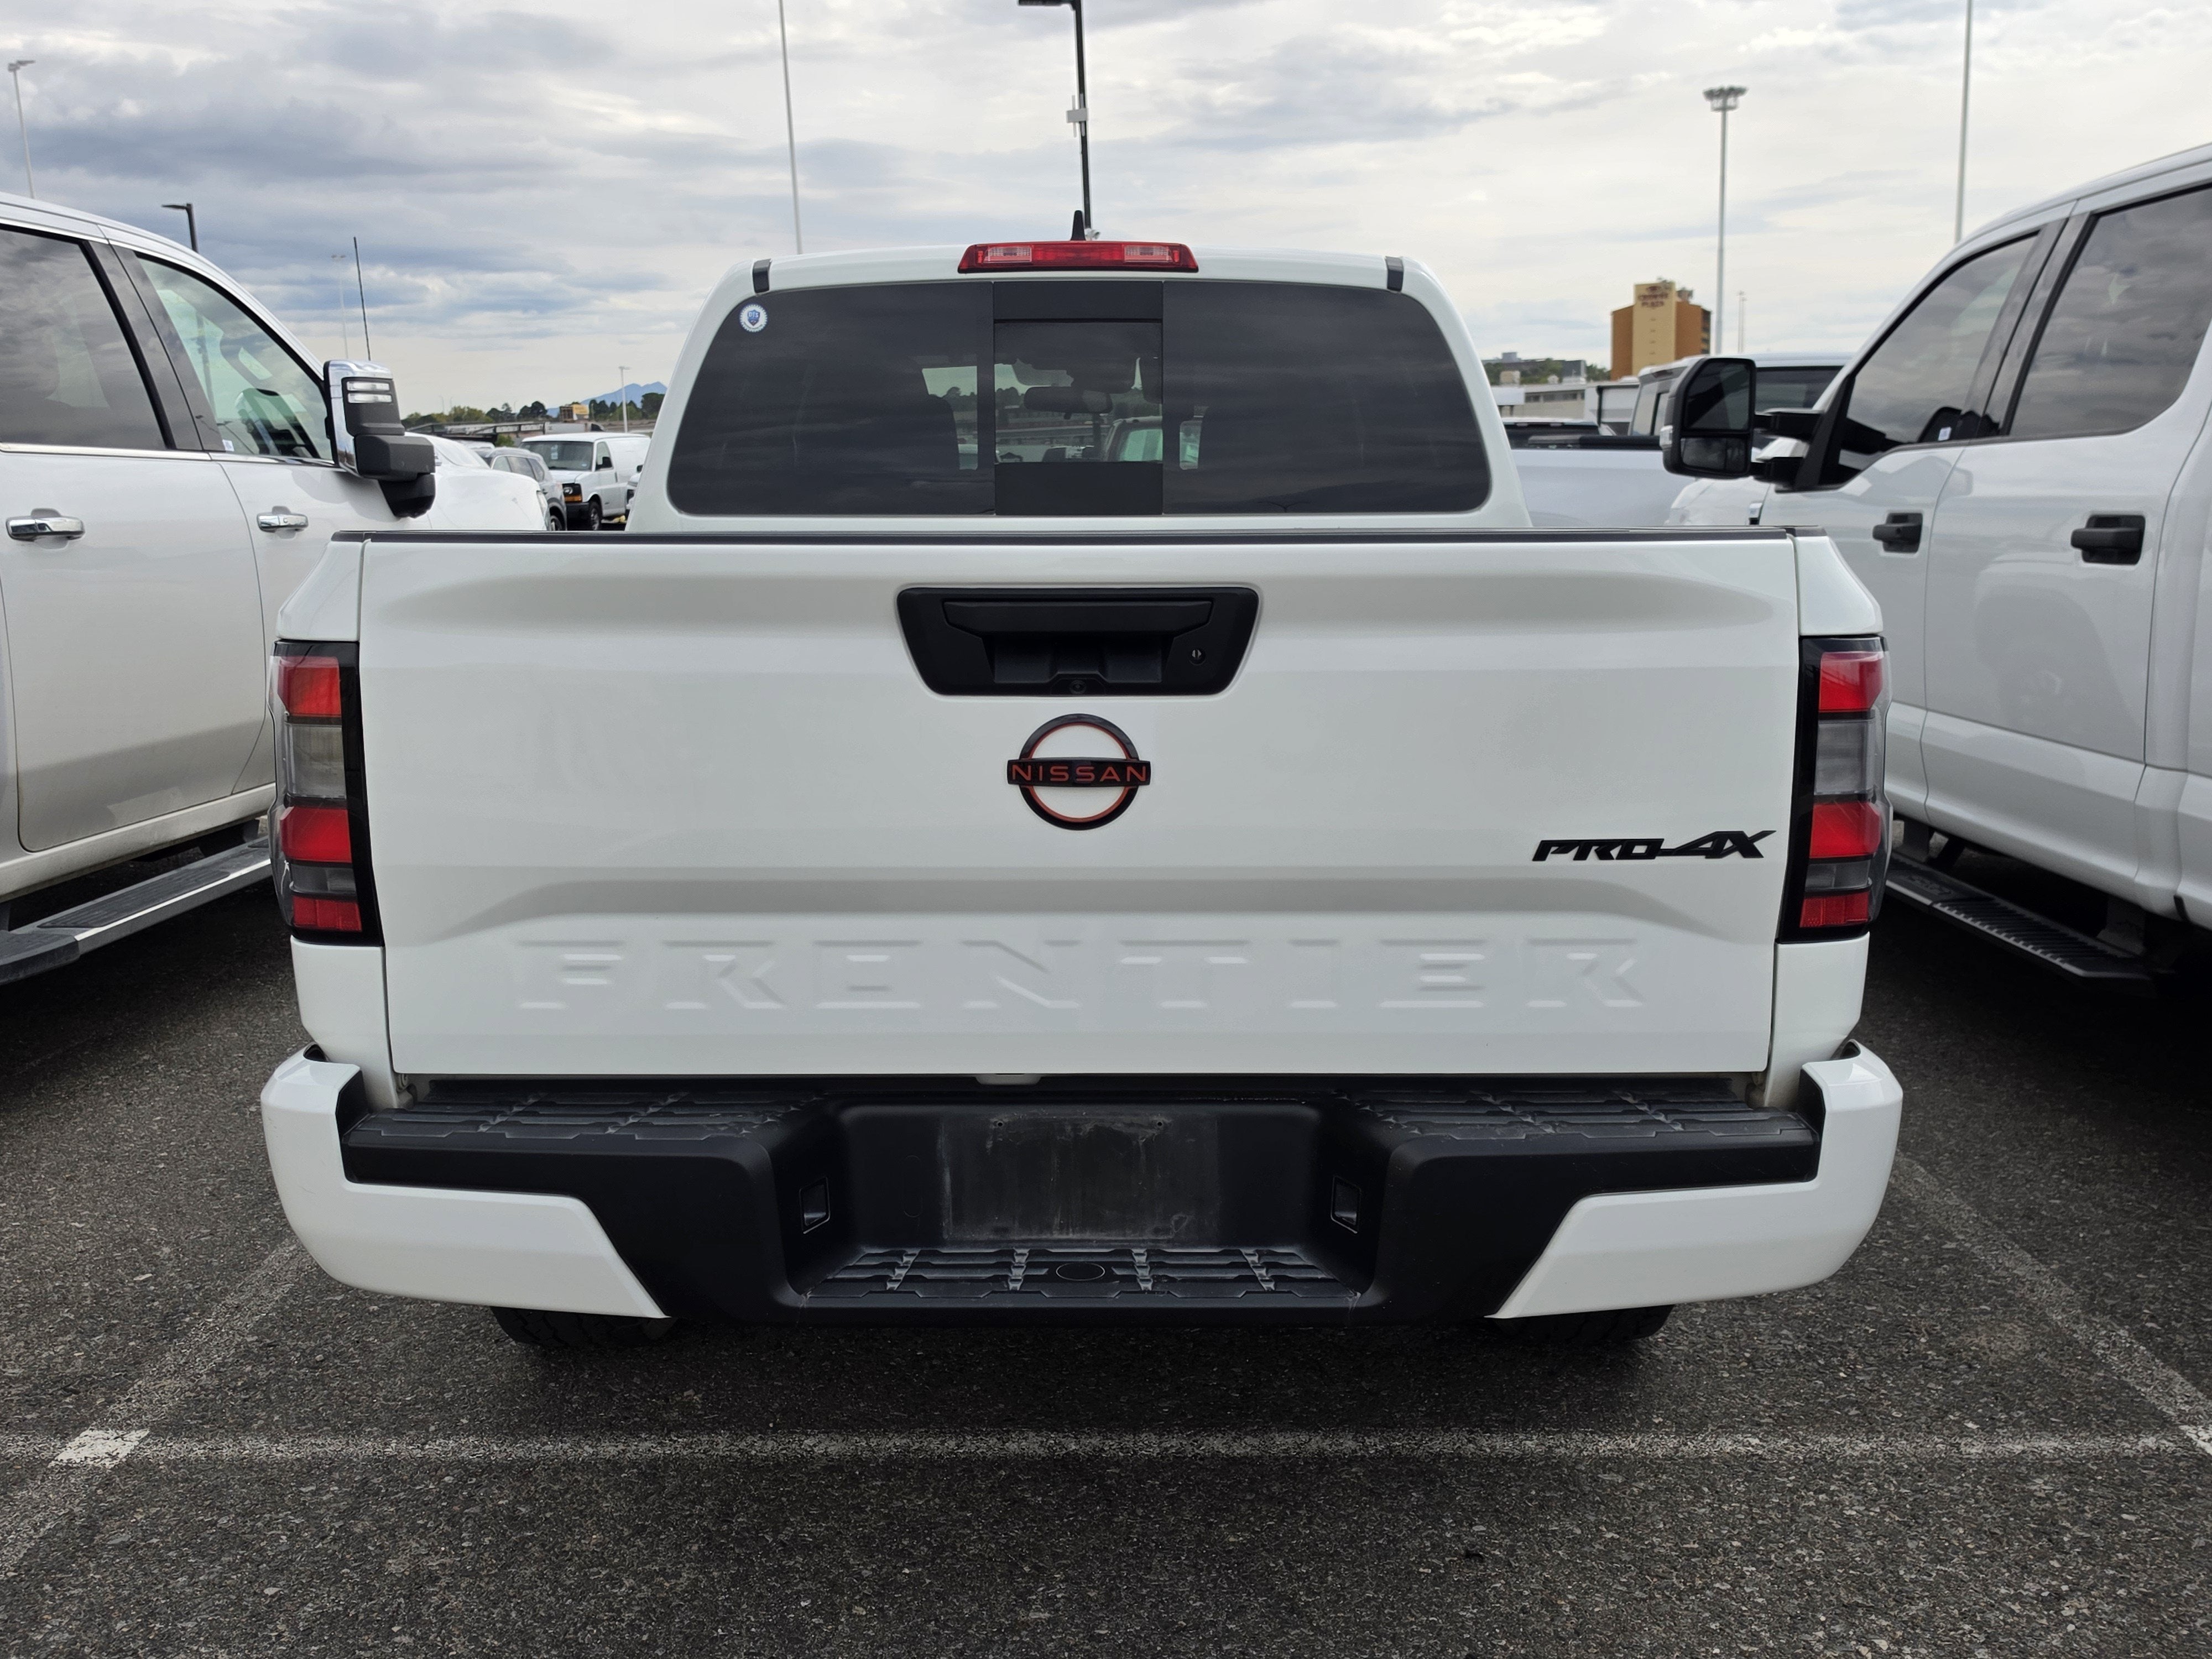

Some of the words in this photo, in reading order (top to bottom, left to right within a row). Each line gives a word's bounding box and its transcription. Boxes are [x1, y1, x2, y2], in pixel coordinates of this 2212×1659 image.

[1012, 765, 1146, 782] NISSAN
[1532, 830, 1777, 861] PRO-4X
[516, 940, 1645, 1009] FRONTIER
